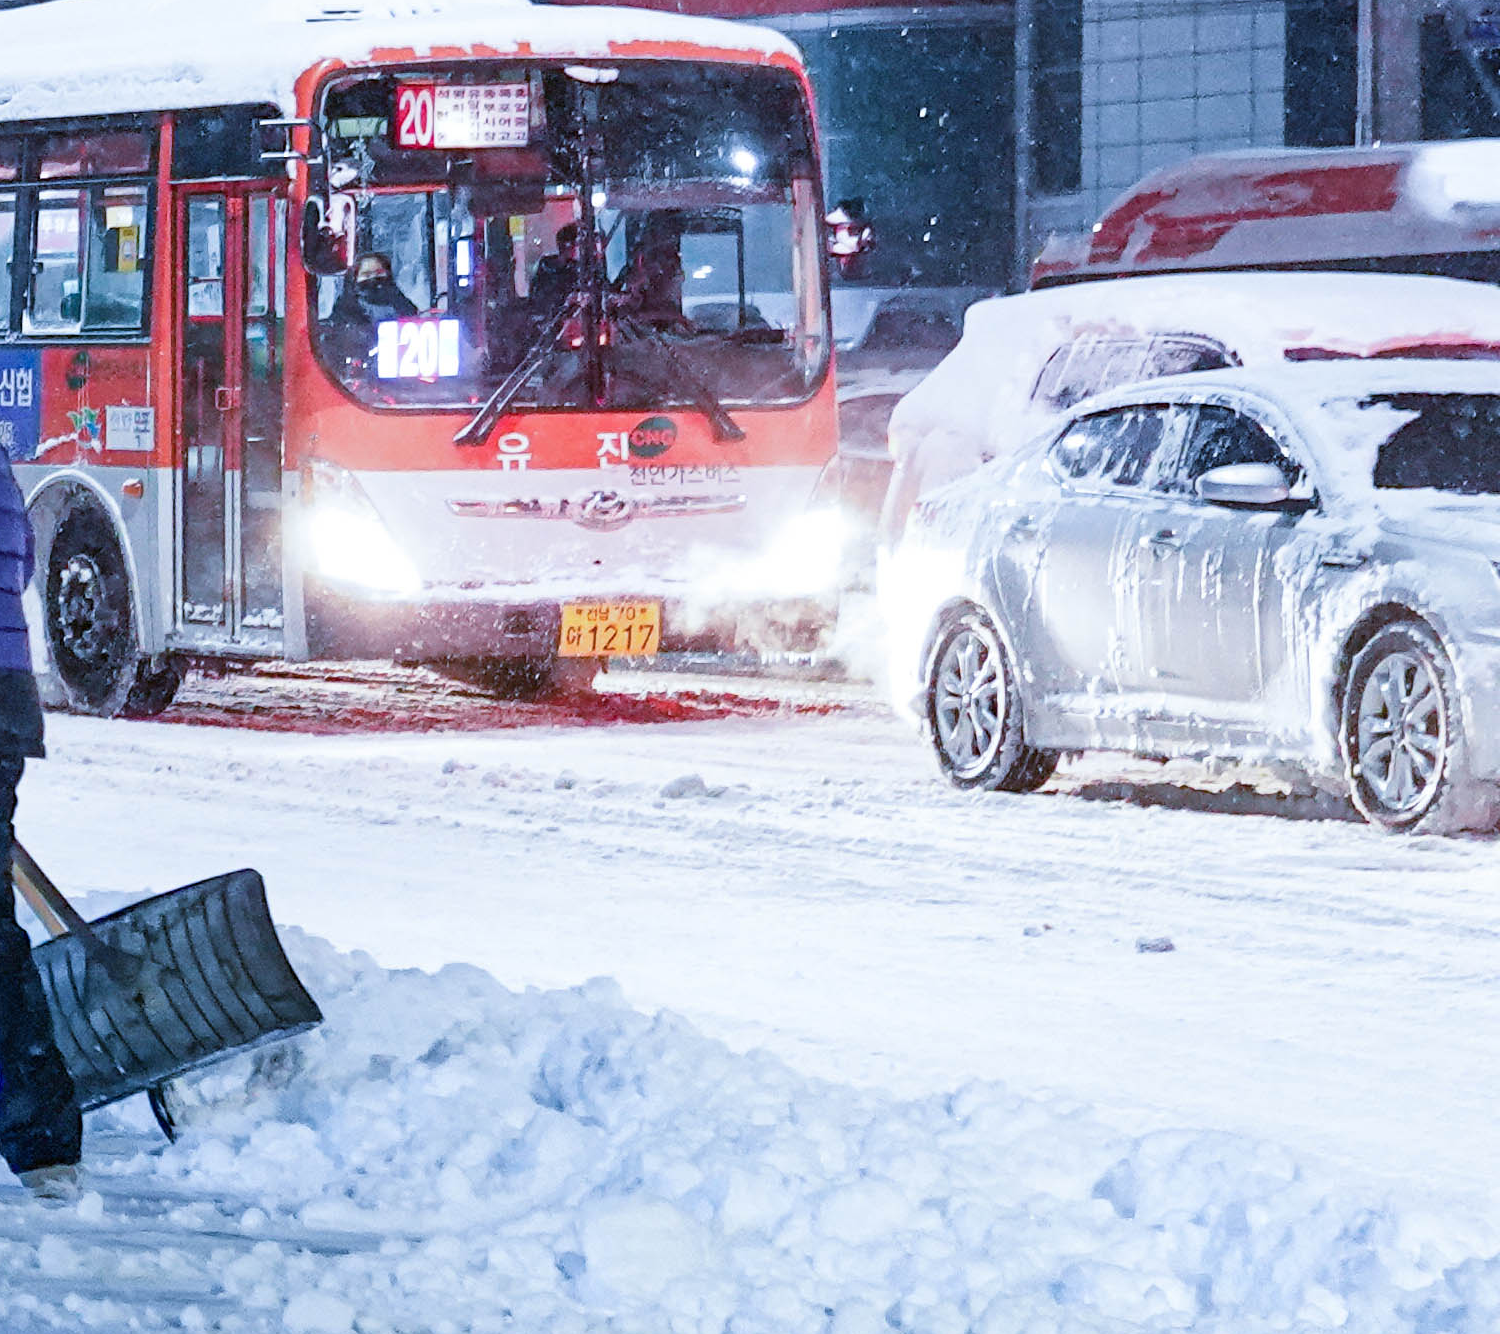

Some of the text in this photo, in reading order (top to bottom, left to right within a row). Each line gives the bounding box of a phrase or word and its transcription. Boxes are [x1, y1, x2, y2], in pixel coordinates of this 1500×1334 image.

[399, 89, 434, 147] 20
[399, 321, 439, 378] 20
[588, 624, 655, 652] 1217
